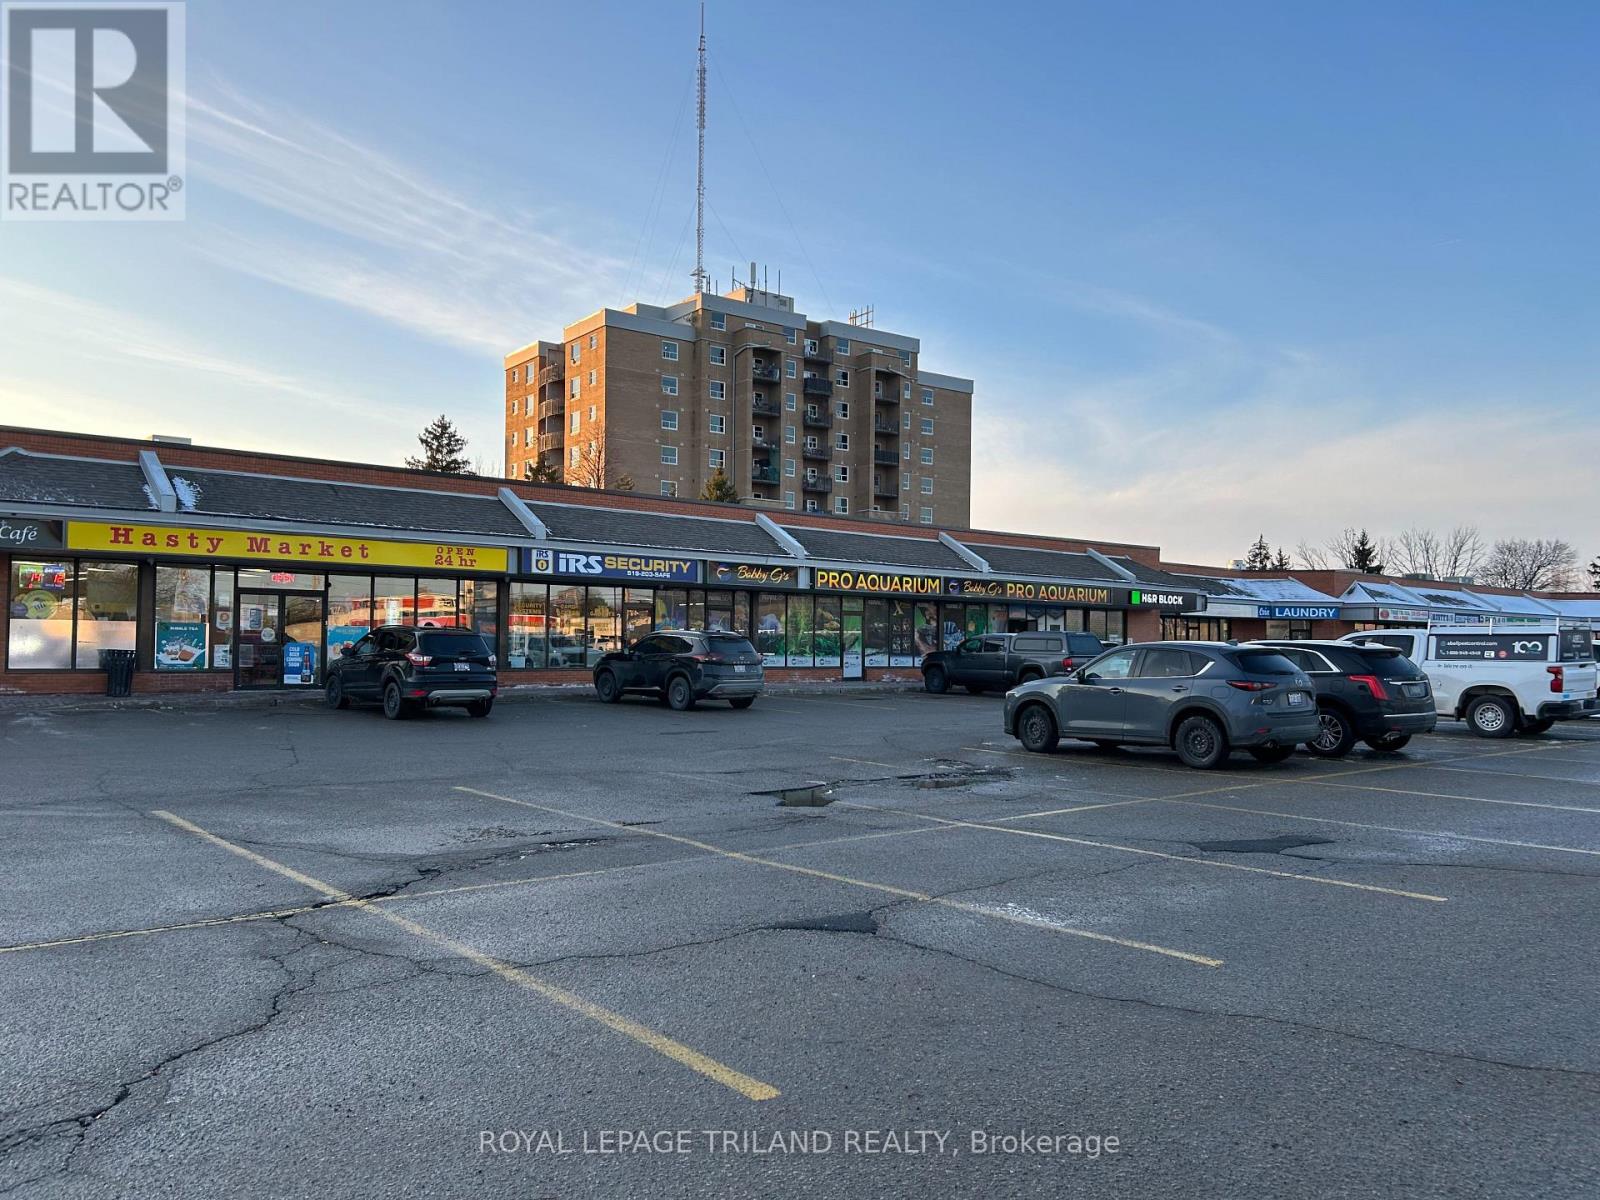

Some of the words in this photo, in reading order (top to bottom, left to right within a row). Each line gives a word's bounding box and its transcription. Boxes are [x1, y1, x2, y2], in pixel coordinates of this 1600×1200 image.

[0, 525, 38, 545] Café
[110, 527, 224, 553] Hasty
[246, 537, 369, 559] Market
[436, 546, 475, 556] OPEN
[435, 555, 453, 566] 24
[458, 556, 476, 567] hr
[604, 556, 691, 573] SECURITY
[737, 565, 768, 584] Bobby
[817, 572, 853, 589] PRO
[855, 574, 940, 594] AQUARIUM
[1007, 583, 1035, 599] PRO
[1038, 585, 1108, 603] AQUARIUM
[1141, 593, 1158, 604] H&R
[1158, 594, 1184, 605] BLOCK
[1275, 607, 1336, 618] LAUNDRY
[1512, 641, 1543, 654] 100
